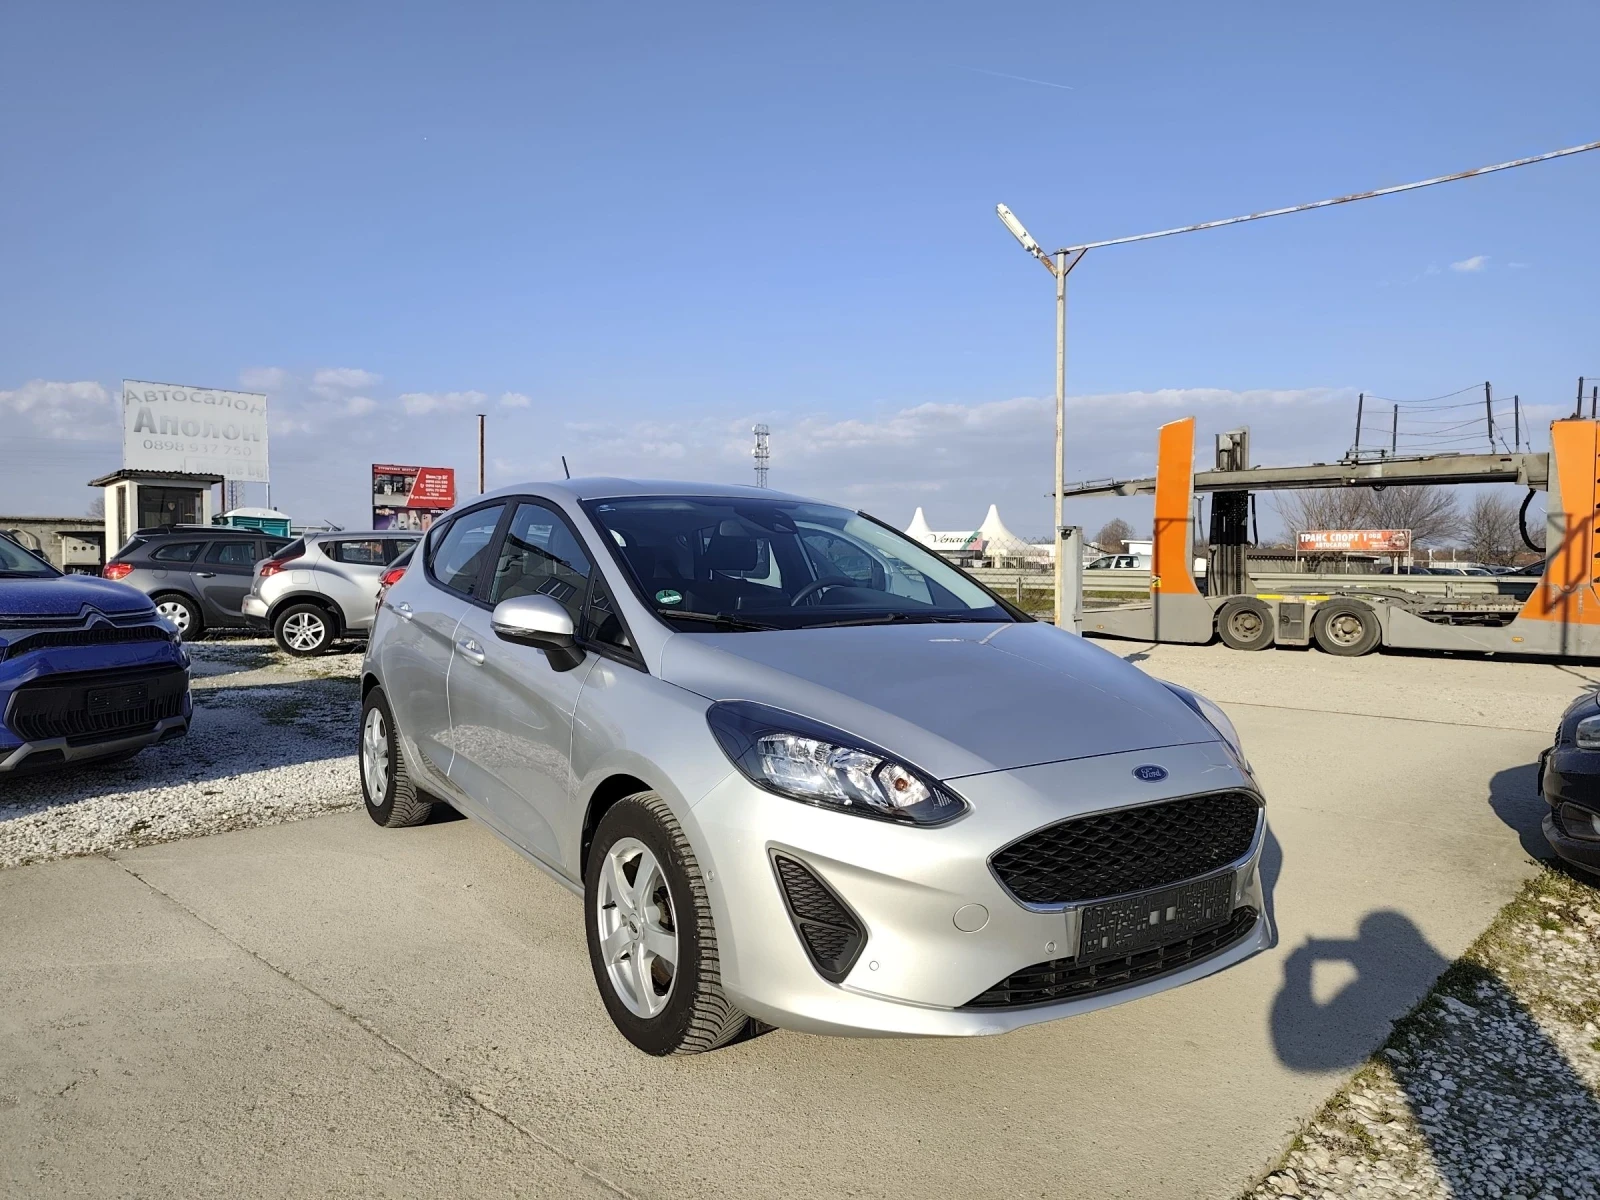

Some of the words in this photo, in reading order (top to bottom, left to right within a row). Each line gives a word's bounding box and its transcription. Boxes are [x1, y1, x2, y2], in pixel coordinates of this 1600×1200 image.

[133, 406, 260, 442] Аполон
[143, 439, 184, 452] 0898
[927, 533, 978, 543] Venauto
[1300, 533, 1327, 542] ТРАНС
[1330, 533, 1359, 542] СПОРТ
[1315, 541, 1351, 549] АВТОСАЛОН
[1140, 767, 1162, 779] Ford
